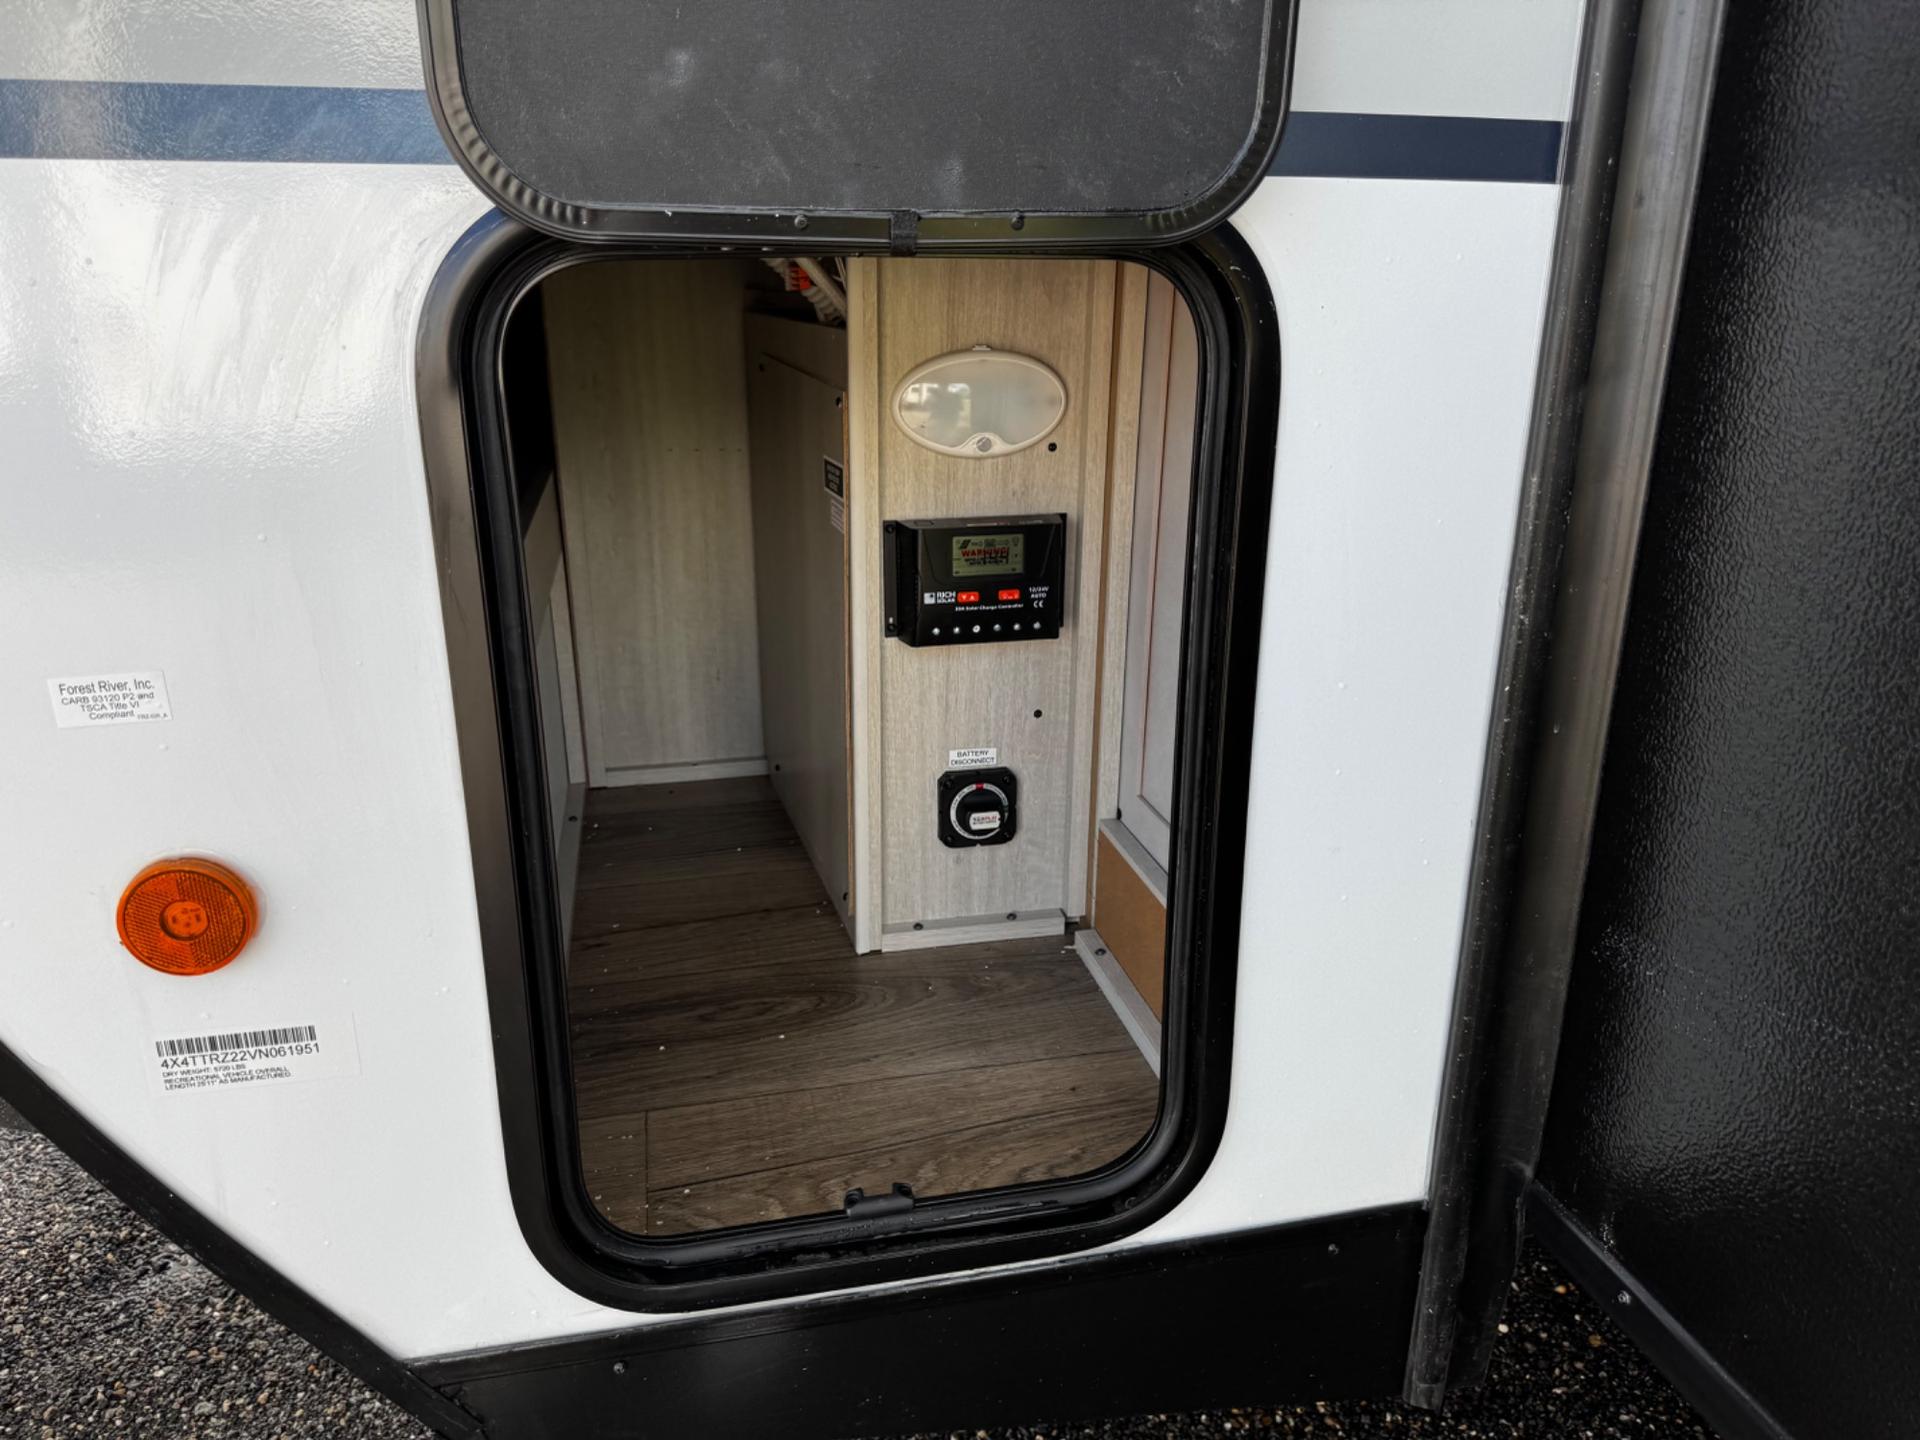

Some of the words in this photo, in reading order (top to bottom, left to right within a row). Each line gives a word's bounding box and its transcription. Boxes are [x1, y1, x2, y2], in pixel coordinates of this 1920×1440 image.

[58, 683, 96, 696] Forest
[98, 680, 132, 693] River,
[134, 678, 155, 690] Inc.
[61, 696, 90, 705] CARB
[92, 694, 121, 703] 93120
[122, 692, 135, 701] P2
[137, 691, 155, 700] and
[80, 703, 107, 712] TSCA
[109, 702, 128, 710] Title
[89, 710, 135, 721] Compliant
[957, 750, 989, 758] BATTERY
[951, 756, 994, 766] DISCONNECT
[161, 1042, 320, 1070] 4X4TTRZ22VN061951
[164, 1074, 220, 1084] RECREATIONAL
[221, 1070, 253, 1079] VEHICLE
[255, 1066, 289, 1075] OVERALL
[165, 1081, 196, 1091] LENGTH
